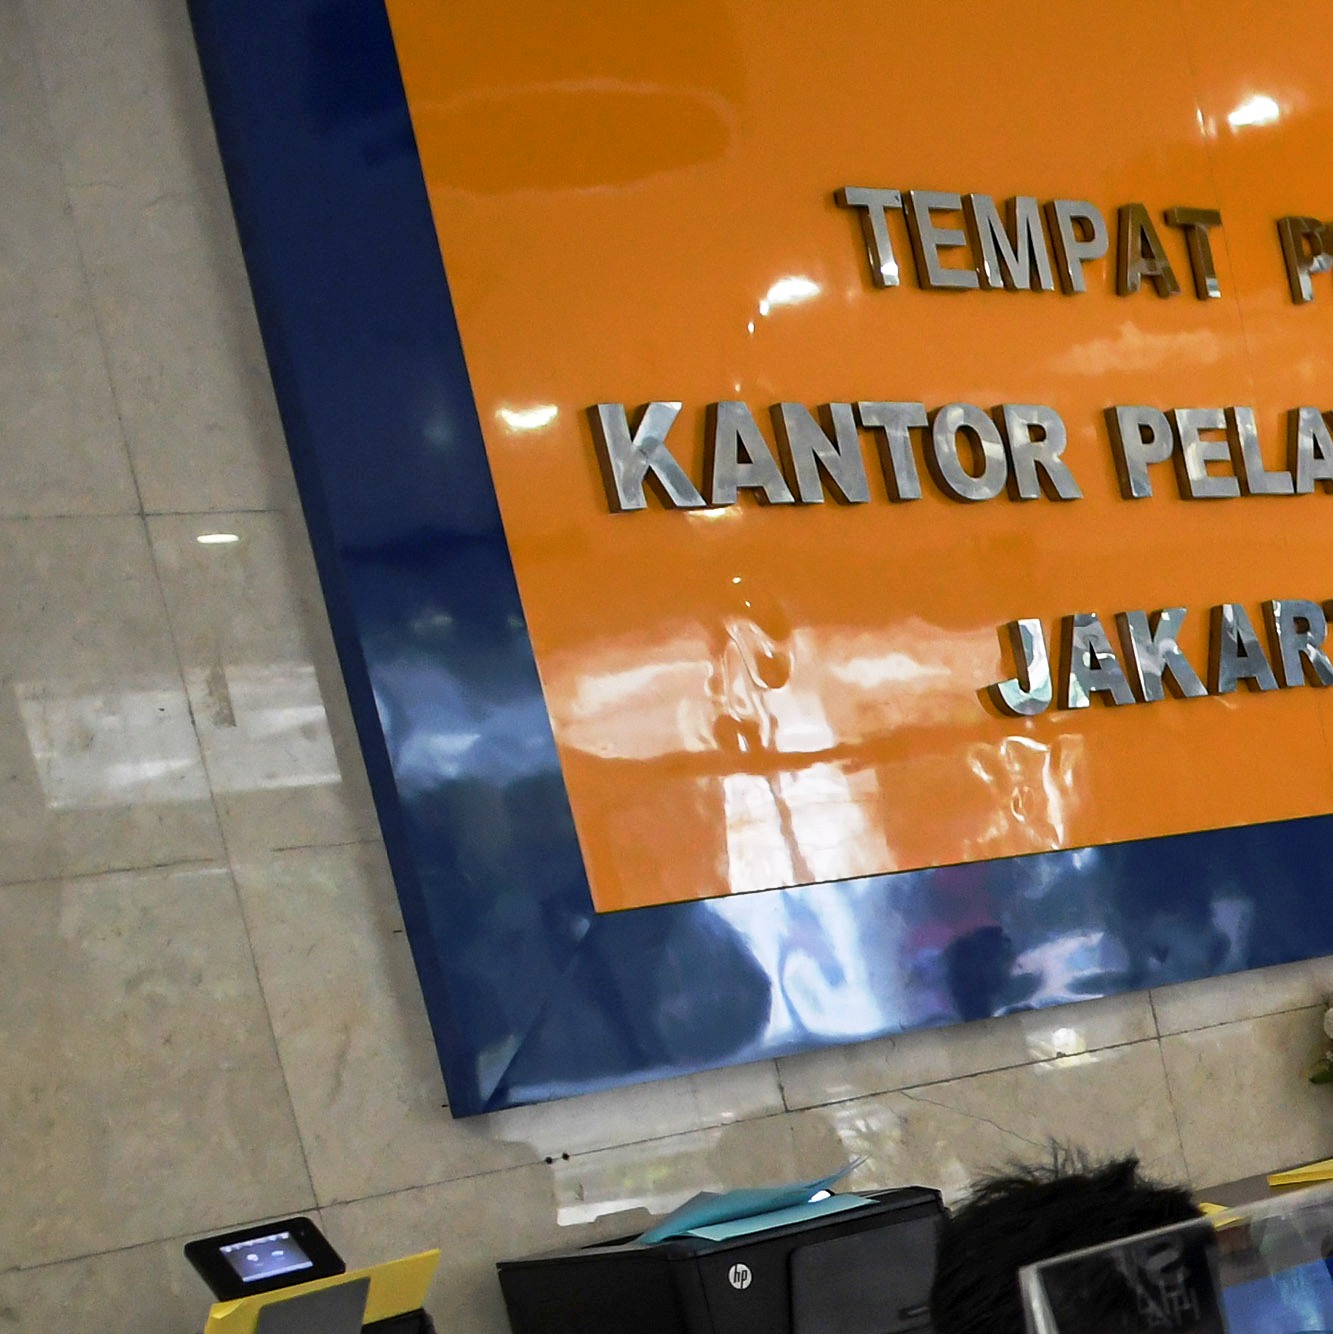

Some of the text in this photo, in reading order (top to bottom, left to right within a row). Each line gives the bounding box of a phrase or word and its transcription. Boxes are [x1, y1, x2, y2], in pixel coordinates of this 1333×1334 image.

[836, 186, 1223, 299] TEMPAT
[586, 401, 1084, 513] KANTOR
[731, 1263, 750, 1289] hp
